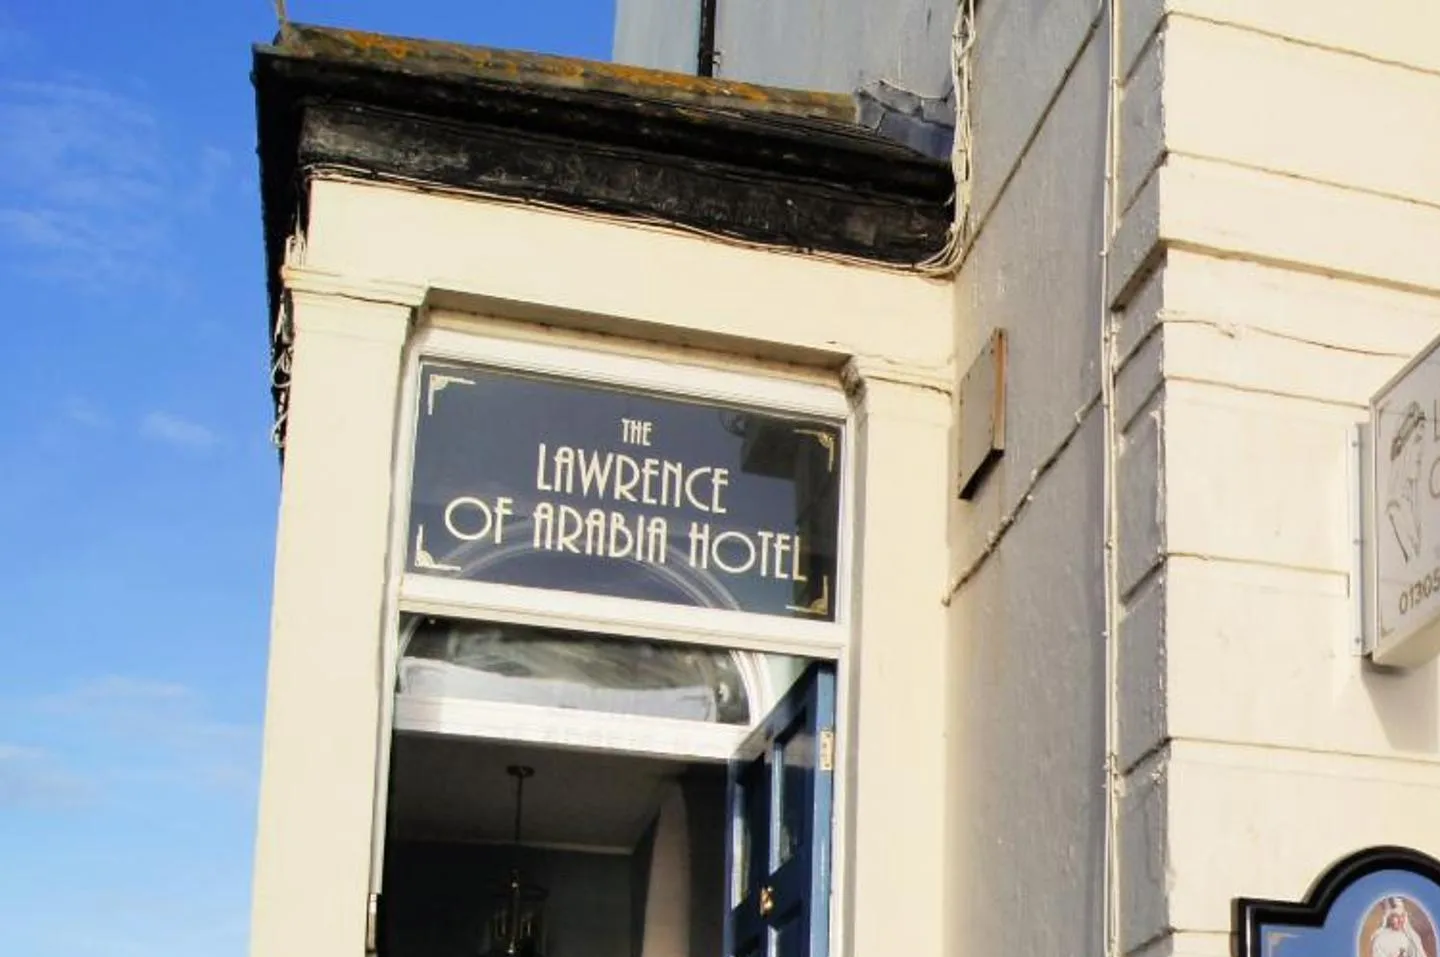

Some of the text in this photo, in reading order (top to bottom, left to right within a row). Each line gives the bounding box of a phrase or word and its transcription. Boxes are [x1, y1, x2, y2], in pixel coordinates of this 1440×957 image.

[621, 418, 652, 447] THE
[536, 443, 729, 515] LAWRENCE
[444, 496, 808, 582] OF ARABIA HOTEL
